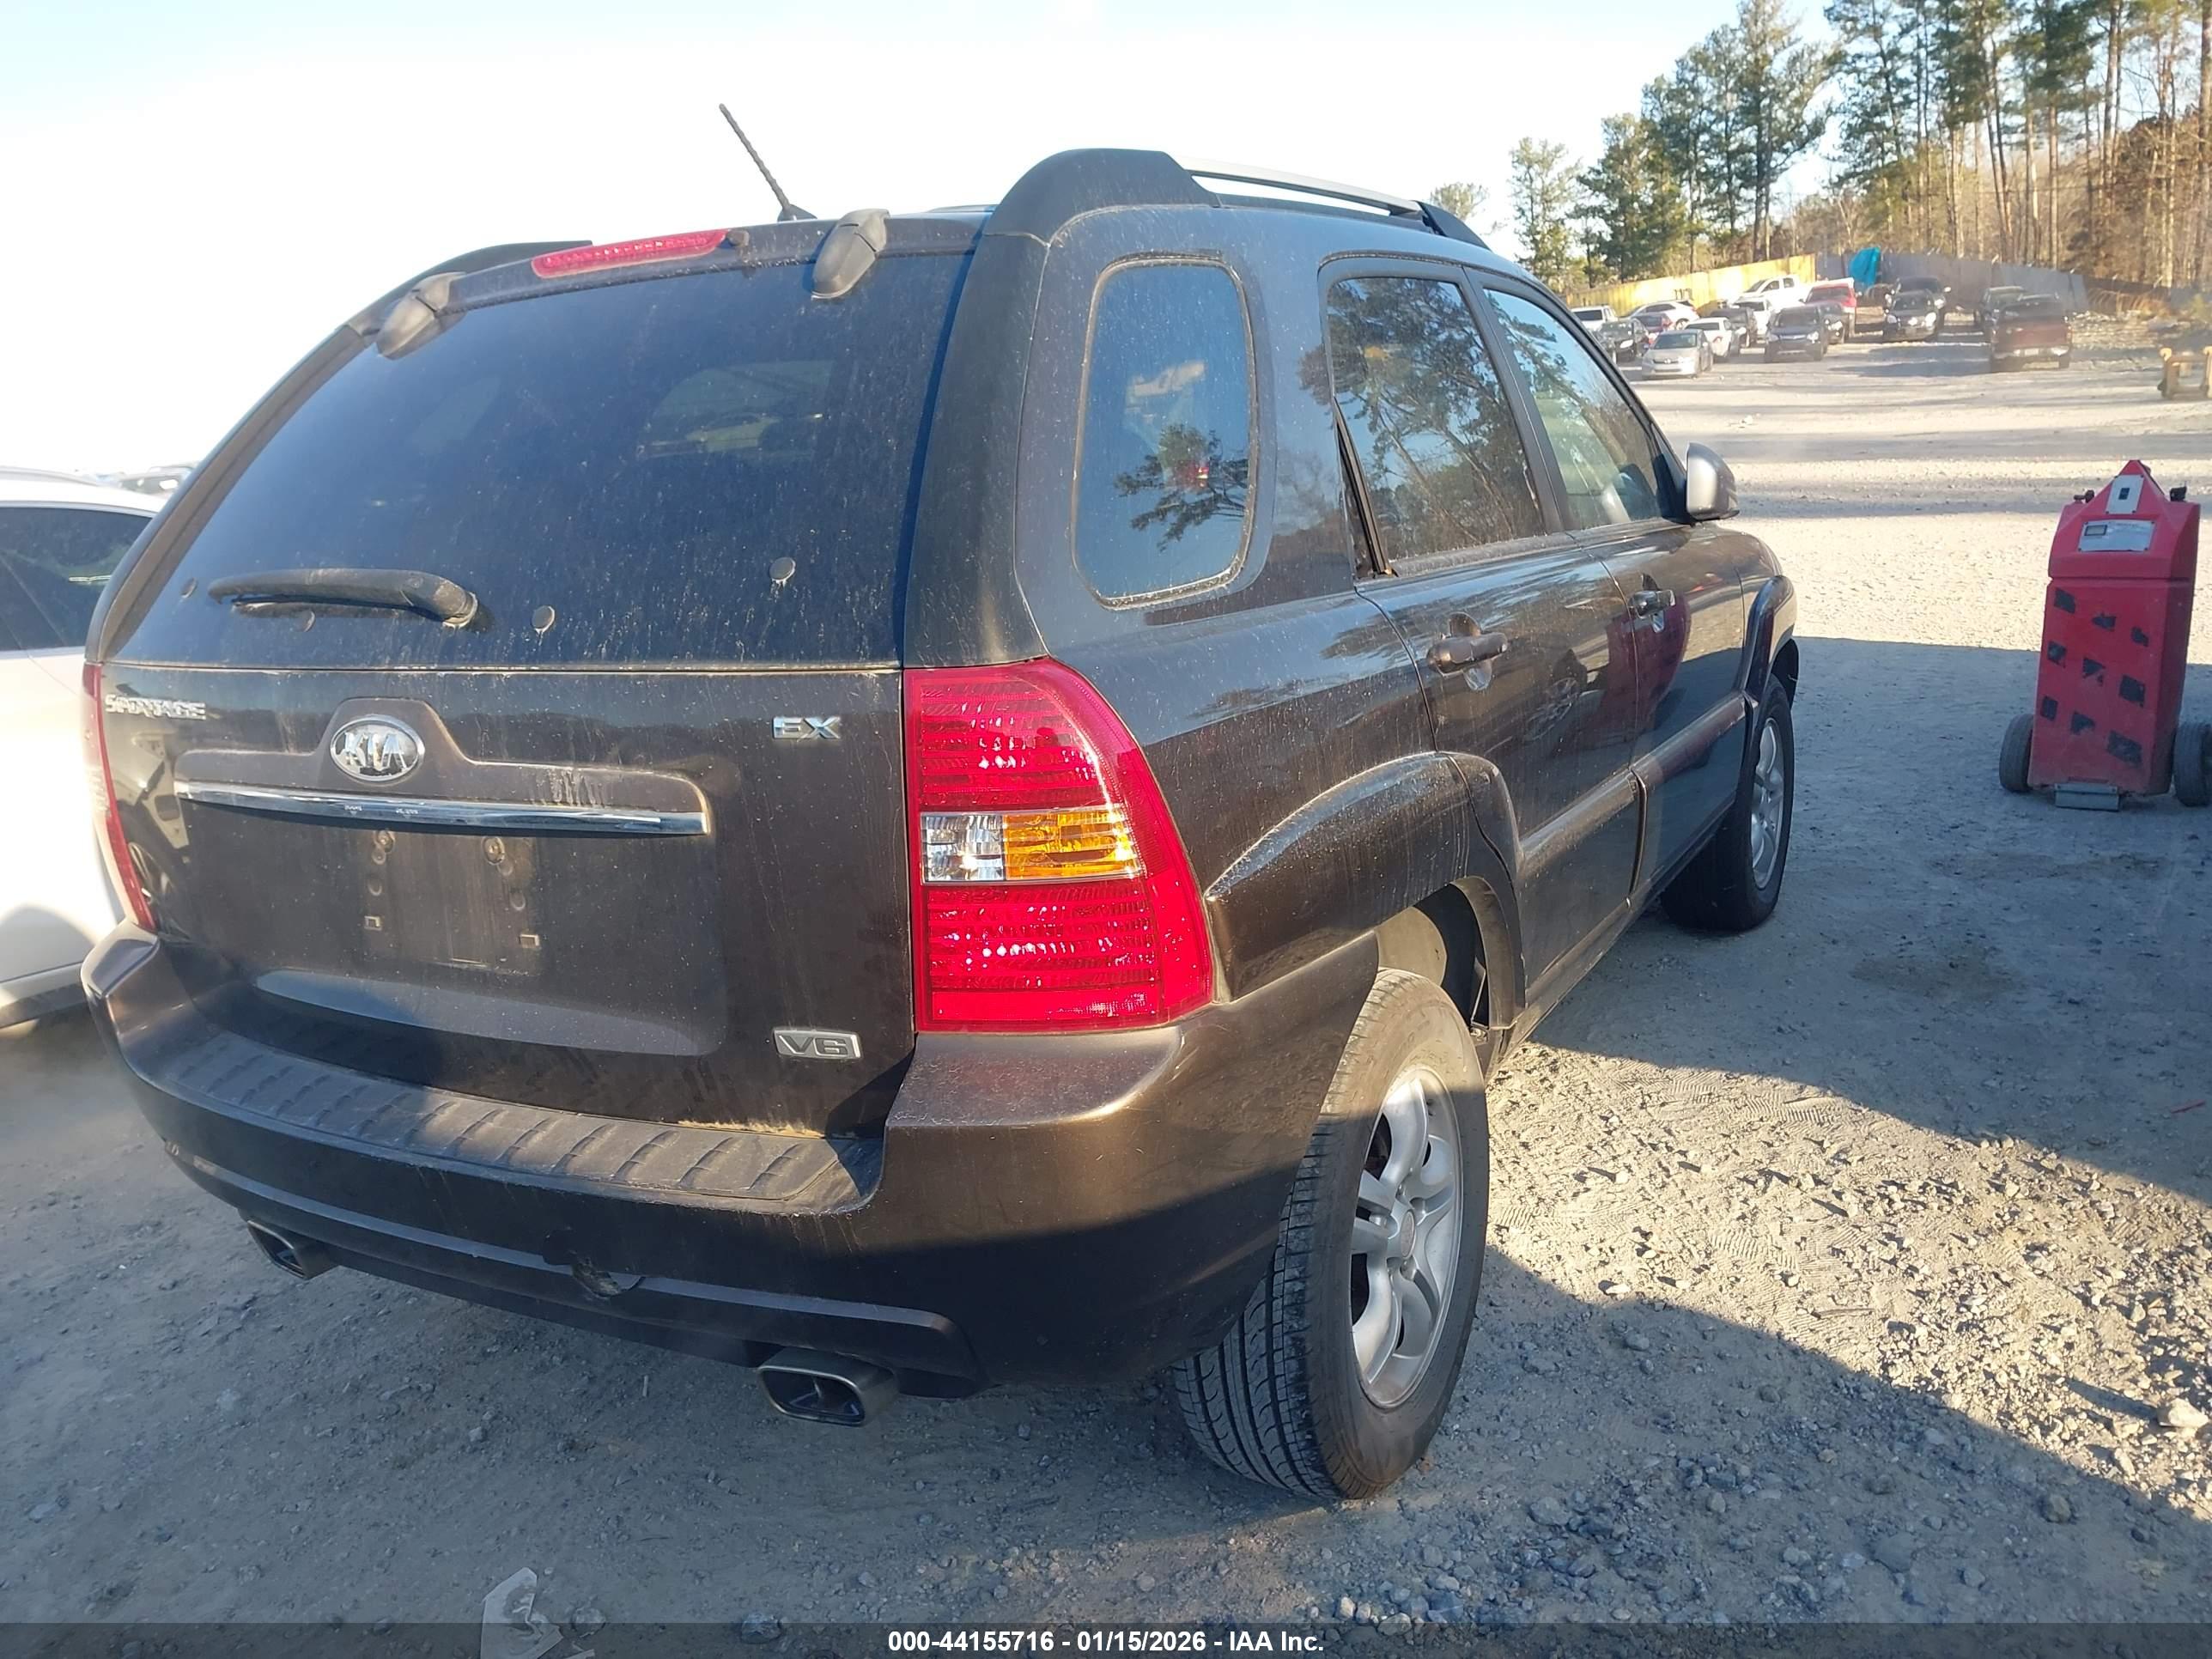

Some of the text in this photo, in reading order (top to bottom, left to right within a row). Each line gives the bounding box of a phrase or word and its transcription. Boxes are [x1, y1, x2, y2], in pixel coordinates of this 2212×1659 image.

[772, 716, 842, 740] EX
[343, 730, 409, 772] KIA
[777, 1034, 850, 1057] V6
